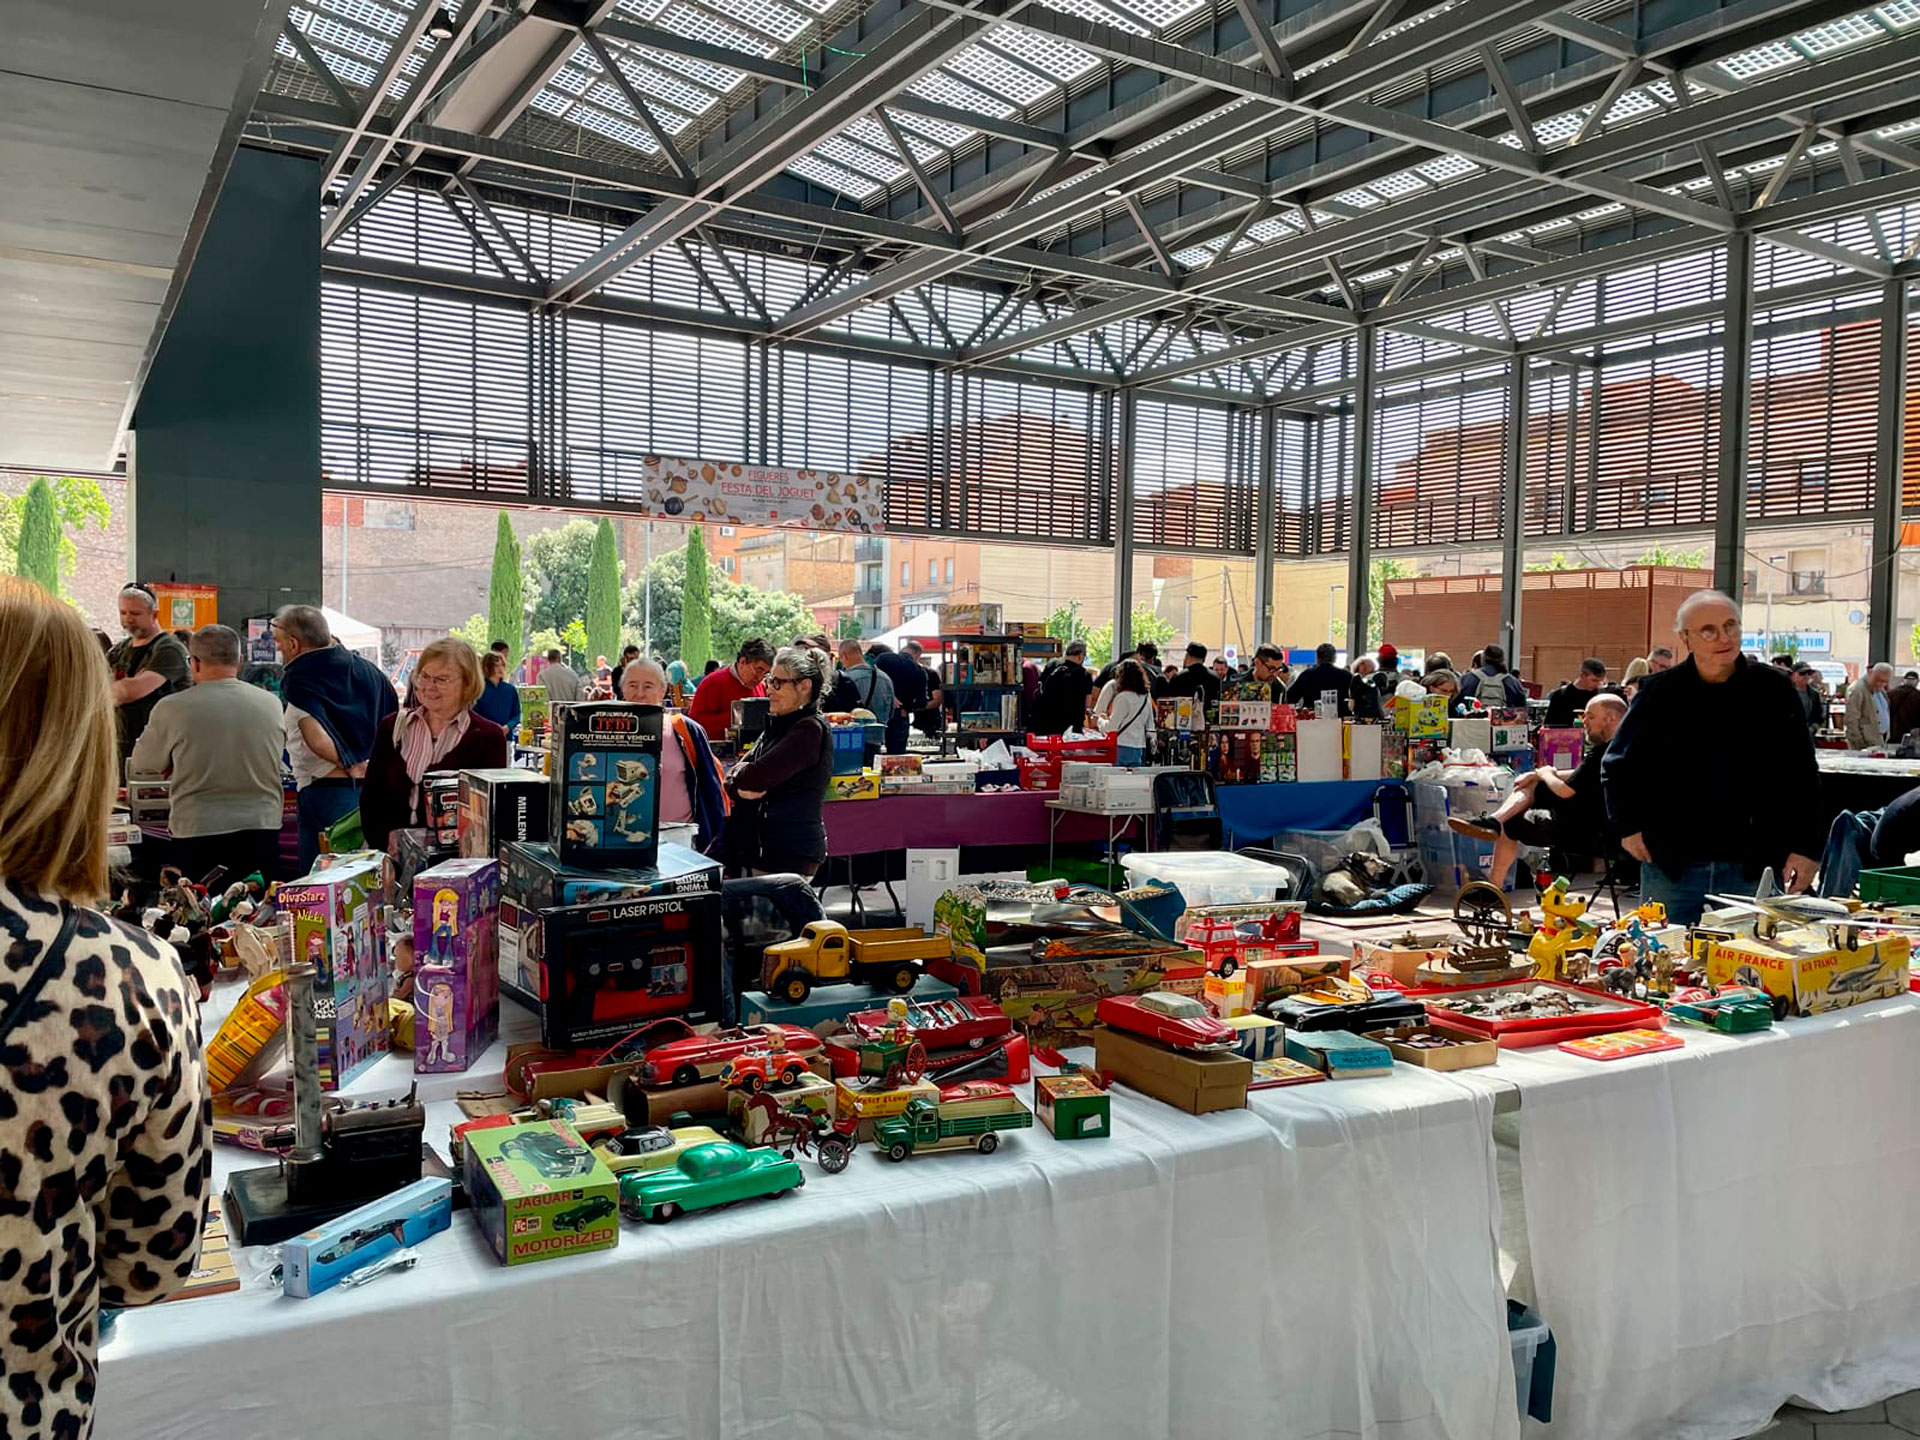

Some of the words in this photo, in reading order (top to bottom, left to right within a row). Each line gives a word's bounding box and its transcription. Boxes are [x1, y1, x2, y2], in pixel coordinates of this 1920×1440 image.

[748, 469, 790, 481] FIGUERES
[721, 482, 752, 494] FESTA
[755, 484, 773, 496] DEL
[778, 486, 815, 499] JOGUET
[596, 717, 631, 731] JEDI
[595, 733, 625, 741] WALKER
[613, 905, 646, 919] LASER
[648, 901, 684, 915] PISTOL
[1715, 949, 1735, 961] AIR
[1738, 953, 1784, 970] FRANCE
[1801, 961, 1813, 972] AIR
[1813, 955, 1838, 970] FRANCE
[1688, 991, 1706, 1002] 10
[514, 1191, 571, 1210] JAGUAR
[513, 1228, 614, 1255] MOTORIZED
